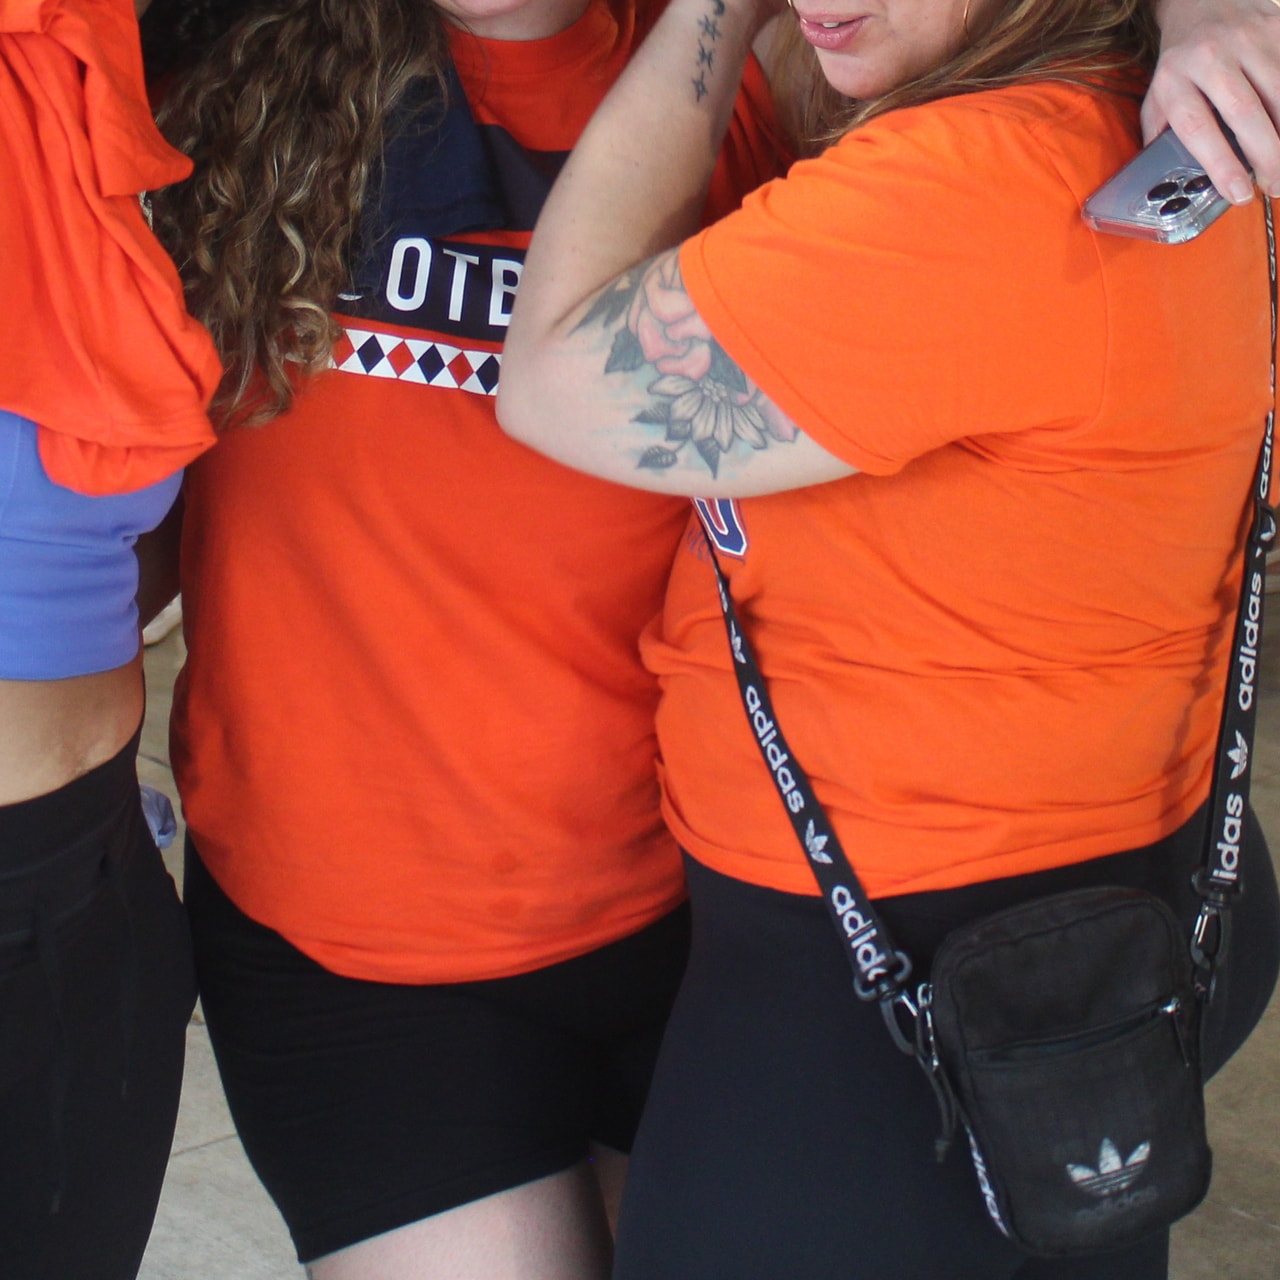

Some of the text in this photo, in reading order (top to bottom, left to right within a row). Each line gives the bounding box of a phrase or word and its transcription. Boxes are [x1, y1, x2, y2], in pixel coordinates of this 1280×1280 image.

[337, 237, 525, 327] OTB
[1238, 571, 1262, 712] adidas
[745, 685, 805, 814] adidas
[1209, 792, 1244, 885] idas
